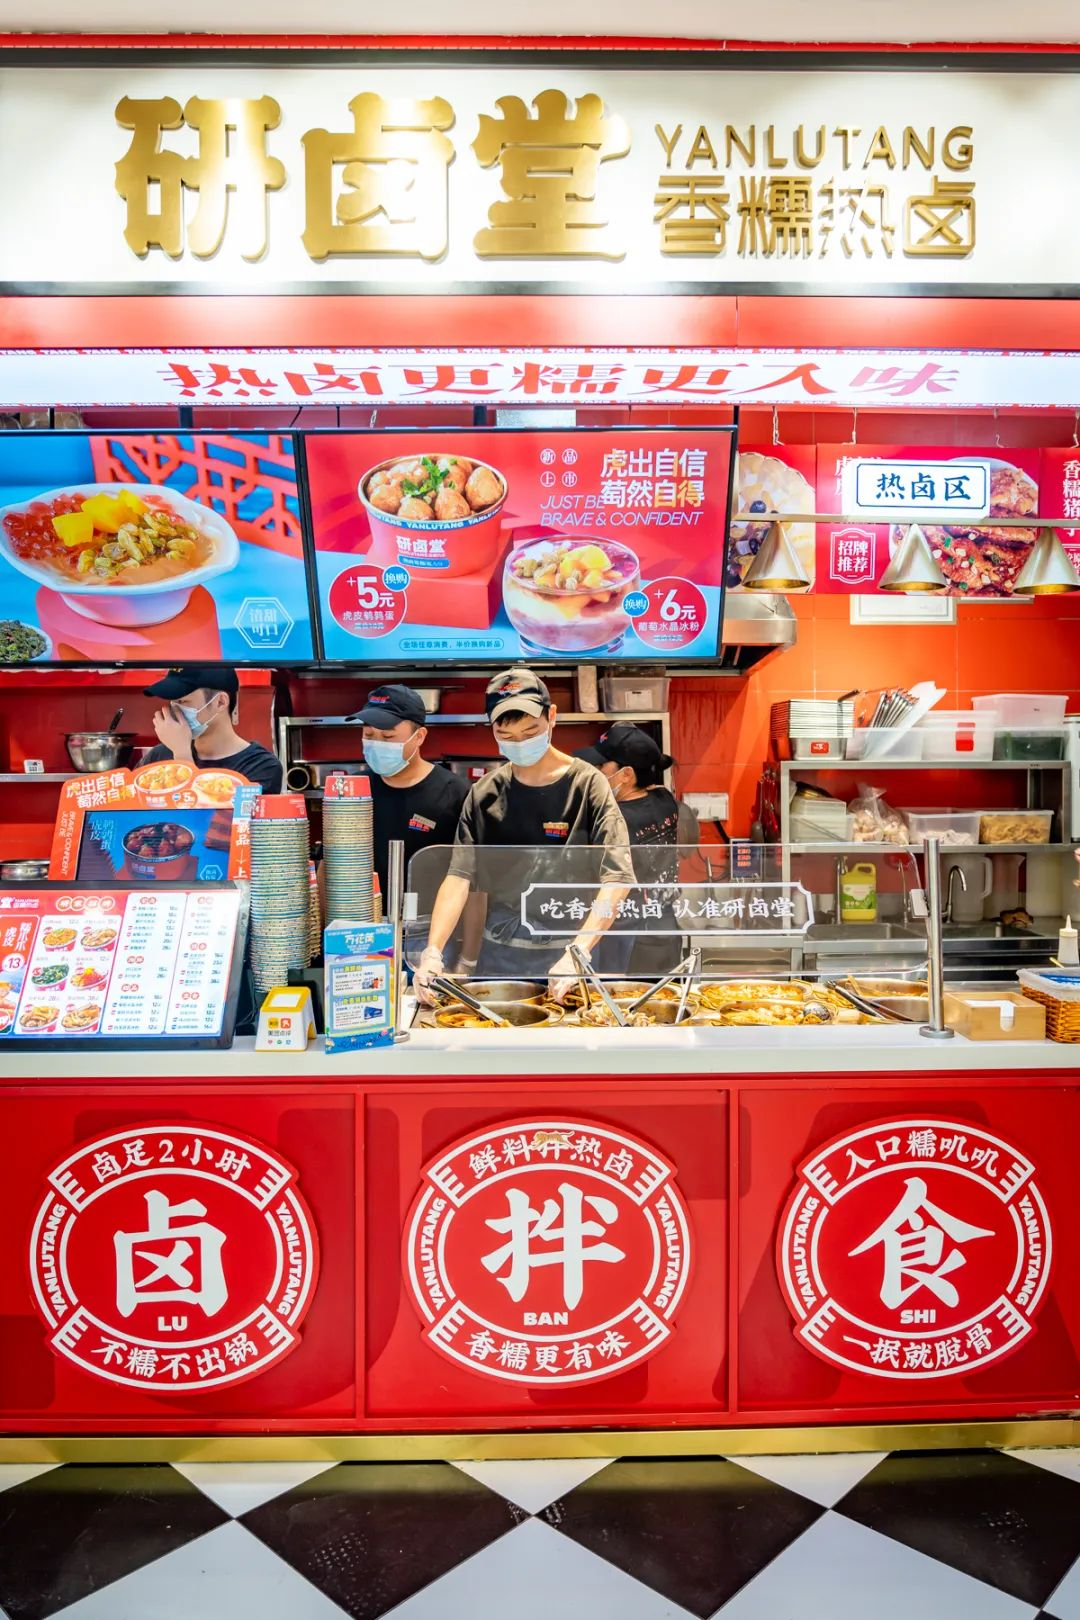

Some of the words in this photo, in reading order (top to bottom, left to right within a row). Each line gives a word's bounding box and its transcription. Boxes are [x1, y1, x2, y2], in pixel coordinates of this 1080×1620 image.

[655, 123, 974, 170] YANLUTANG
[115, 90, 631, 262] 研卤堂
[653, 174, 976, 258] 香糯热卤
[157, 362, 961, 396] 热卤更糯更入味
[600, 448, 708, 478] 虎出自信
[540, 494, 584, 510] JUST
[600, 478, 706, 509] 萄然自得
[875, 472, 972, 502] 热卤区
[540, 512, 595, 527] BRAVE
[595, 512, 607, 526] &
[609, 511, 704, 526] CONFIDENT
[837, 539, 869, 556] 招牌
[837, 555, 869, 573] 推荐
[67, 772, 126, 799] 虎出自信
[673, 898, 796, 920] 认准研卤堂
[91, 1138, 252, 1183] 卤足2小时
[845, 1128, 1002, 1181] 入口糯叽叽
[41, 1203, 68, 1317] YANLUTANG
[113, 1189, 229, 1318] 卤
[275, 1201, 303, 1316] YANLUTANG
[420, 1197, 448, 1311] YANLUTANG
[480, 1182, 627, 1311] 拌
[654, 1196, 681, 1309] YANLUTANG
[792, 1195, 820, 1310] YANLUTANG
[847, 1176, 996, 1310] 食
[1015, 1194, 1042, 1306] YANLUTANG
[157, 1315, 188, 1331] LU
[523, 1312, 569, 1326] BAN
[899, 1309, 937, 1324] SHI
[90, 1332, 259, 1380] 不糯不出锅
[464, 1329, 632, 1374] 香糯更有味
